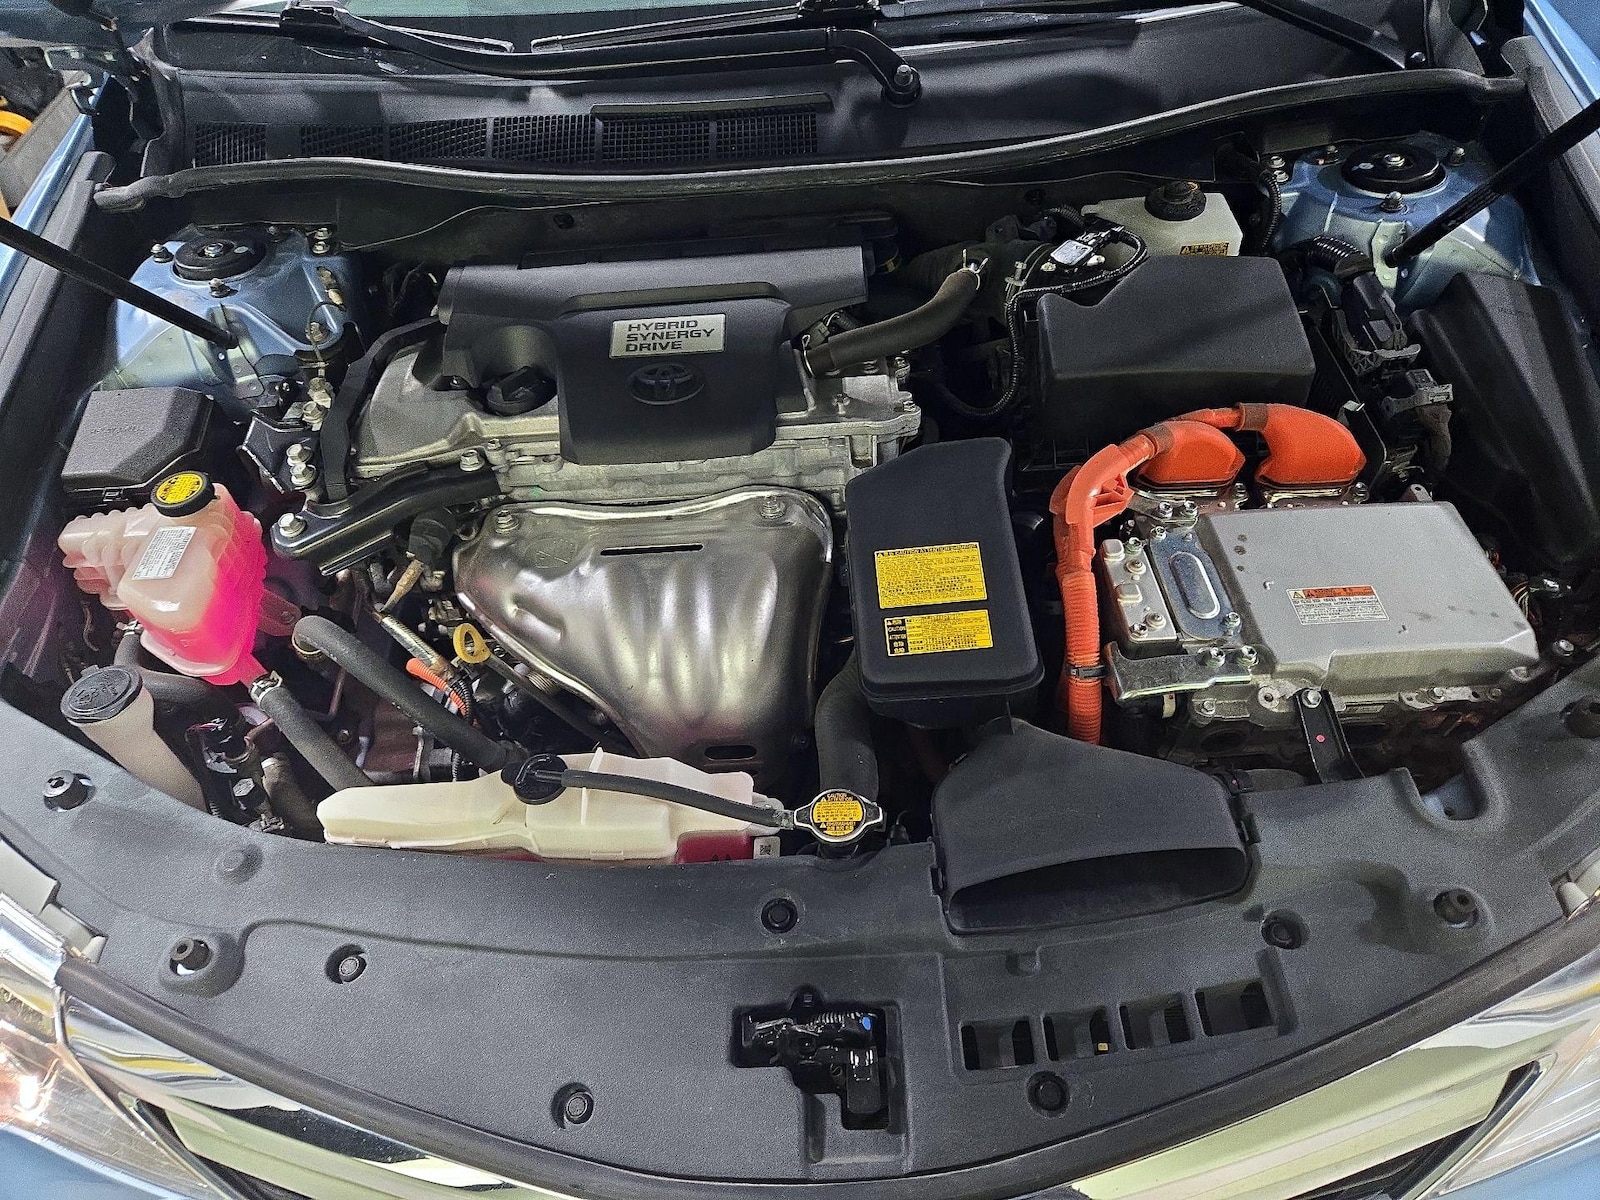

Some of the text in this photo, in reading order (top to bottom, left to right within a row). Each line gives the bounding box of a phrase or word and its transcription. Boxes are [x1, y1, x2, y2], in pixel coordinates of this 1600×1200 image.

[628, 320, 699, 331] HYBRID
[626, 328, 715, 341] SYNERGY
[625, 340, 683, 352] DRIVE
